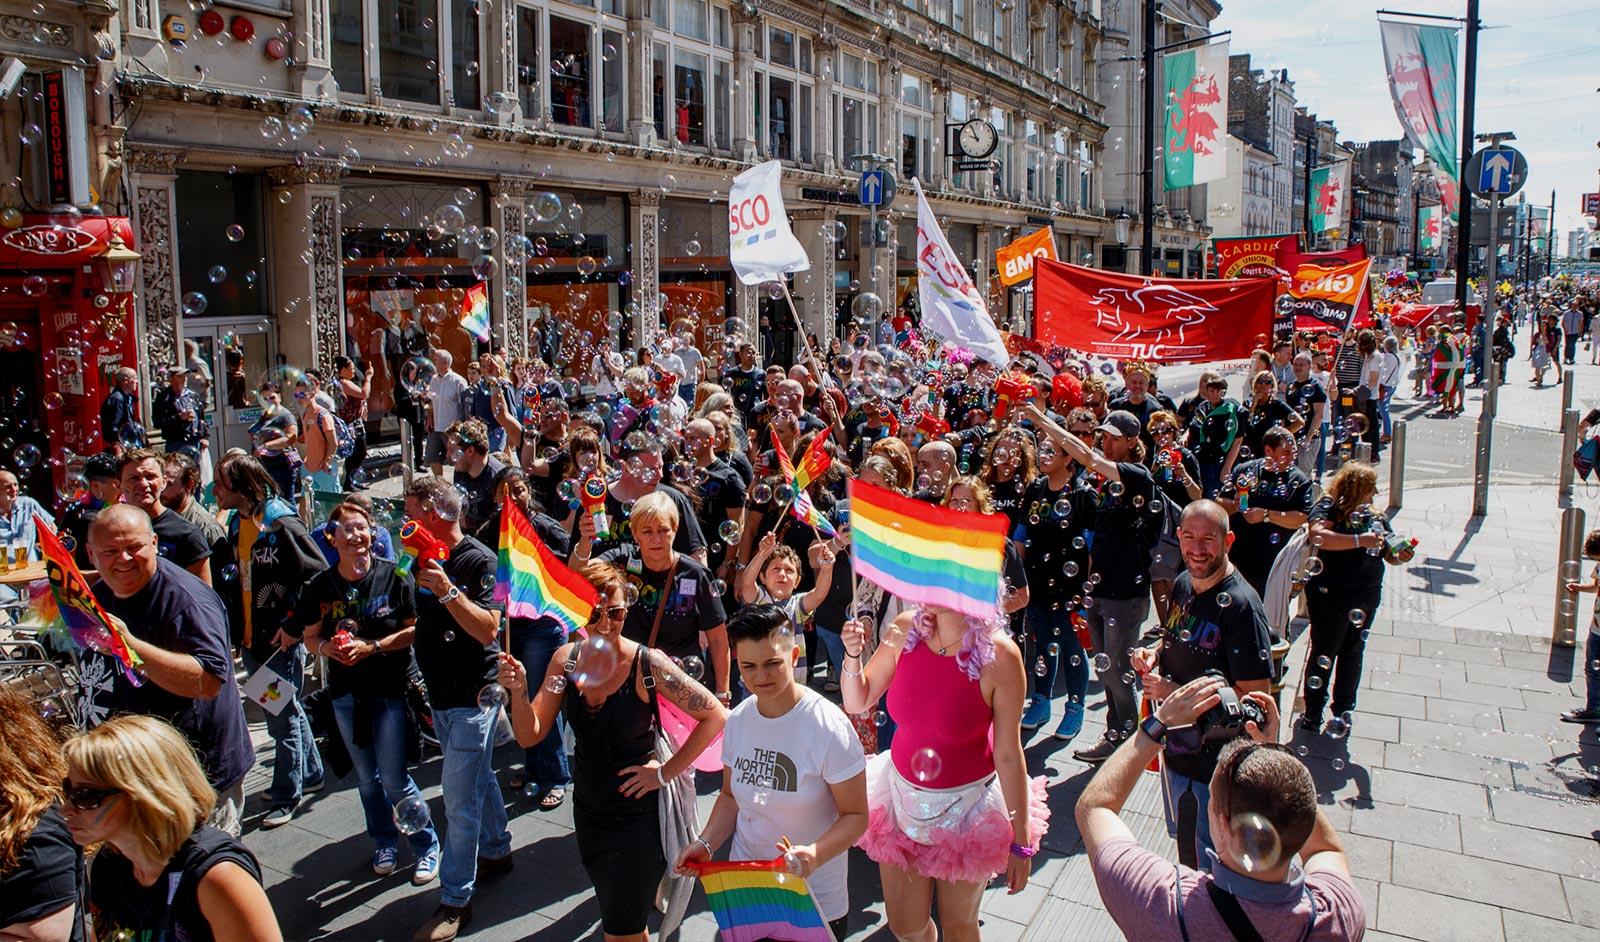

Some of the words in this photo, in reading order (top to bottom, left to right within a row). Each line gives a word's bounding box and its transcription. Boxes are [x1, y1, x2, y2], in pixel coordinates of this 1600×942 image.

[48, 83, 64, 180] BOROUGH
[66, 232, 77, 248] 8
[1242, 255, 1268, 264] UNION
[1130, 343, 1166, 360] TUC
[754, 747, 776, 764] THE
[733, 756, 774, 776] NORTH
[740, 771, 773, 789] FACE
